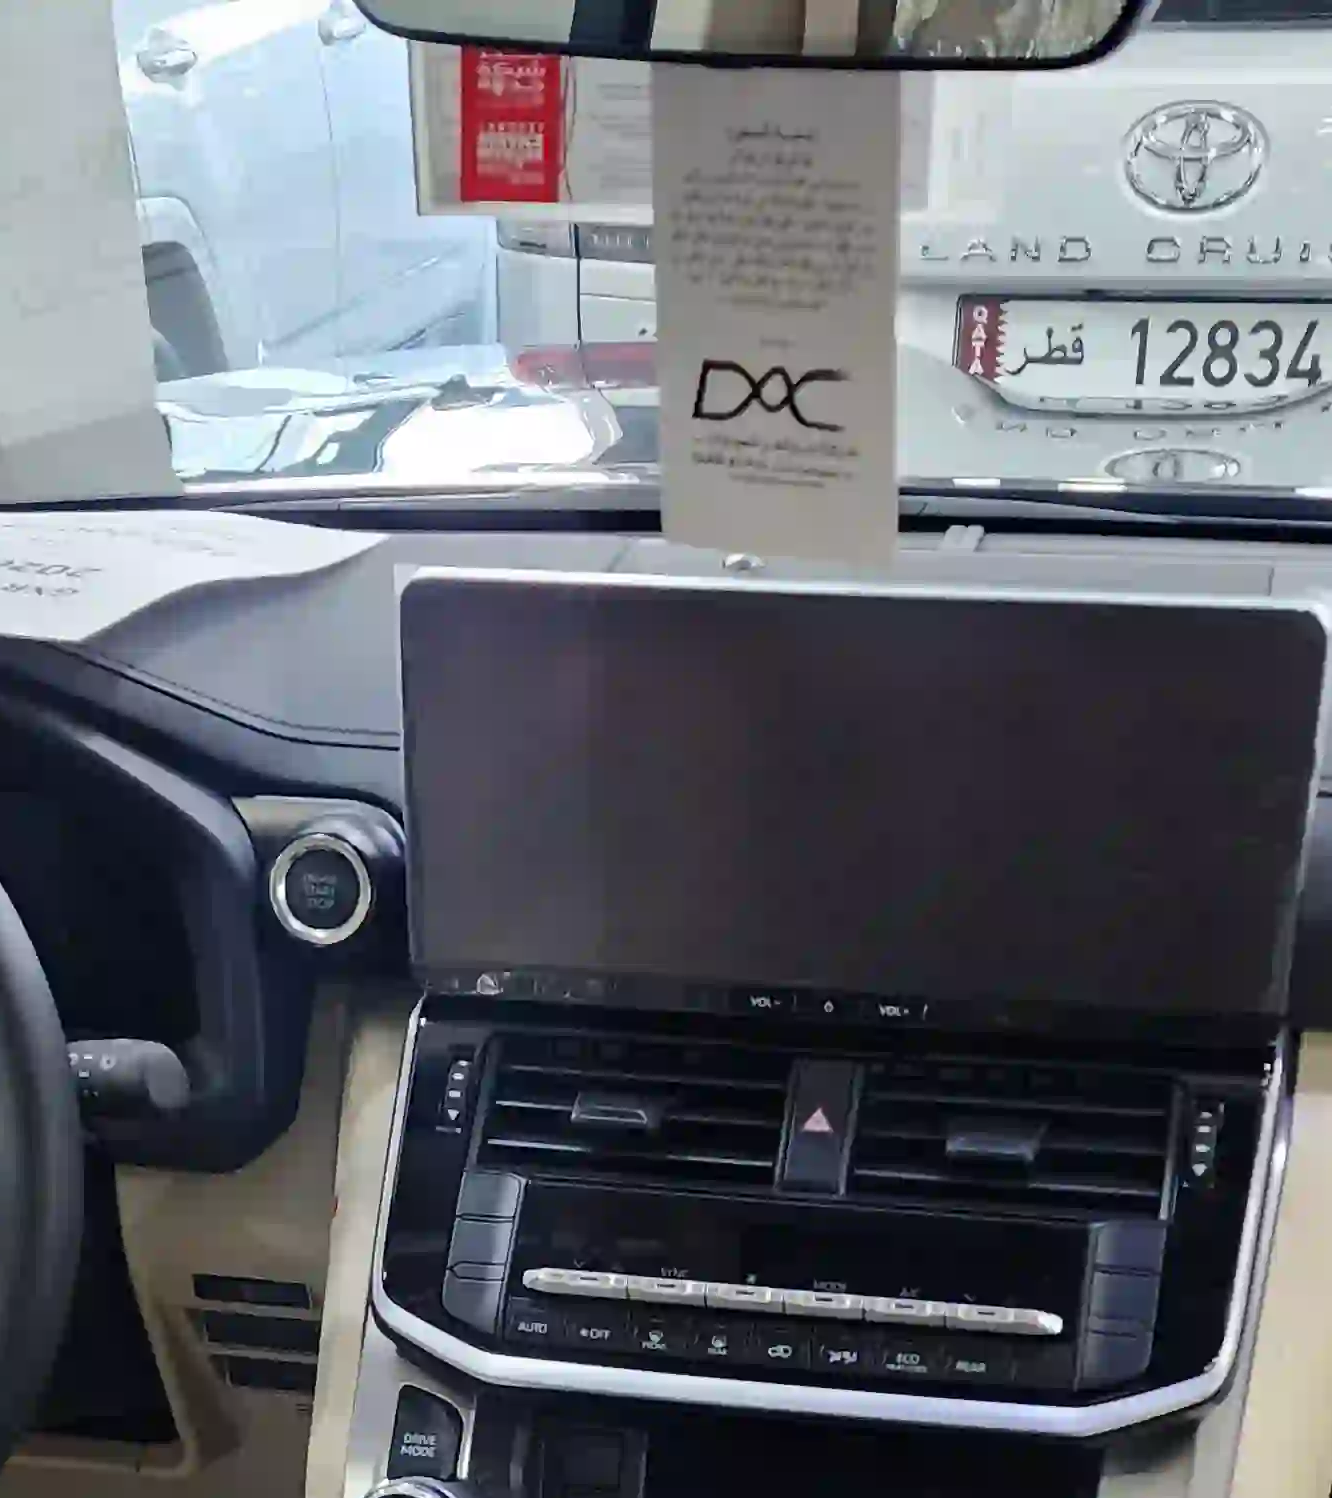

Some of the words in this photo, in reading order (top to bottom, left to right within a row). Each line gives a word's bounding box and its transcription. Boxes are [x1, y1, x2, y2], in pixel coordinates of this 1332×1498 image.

[920, 236, 1093, 264] LAND
[968, 305, 989, 376] QATA
[1005, 322, 1086, 375] قطر
[518, 1321, 548, 1335] AUTO
[403, 1431, 438, 1445] DRIVE
[400, 1445, 437, 1458] MODE
